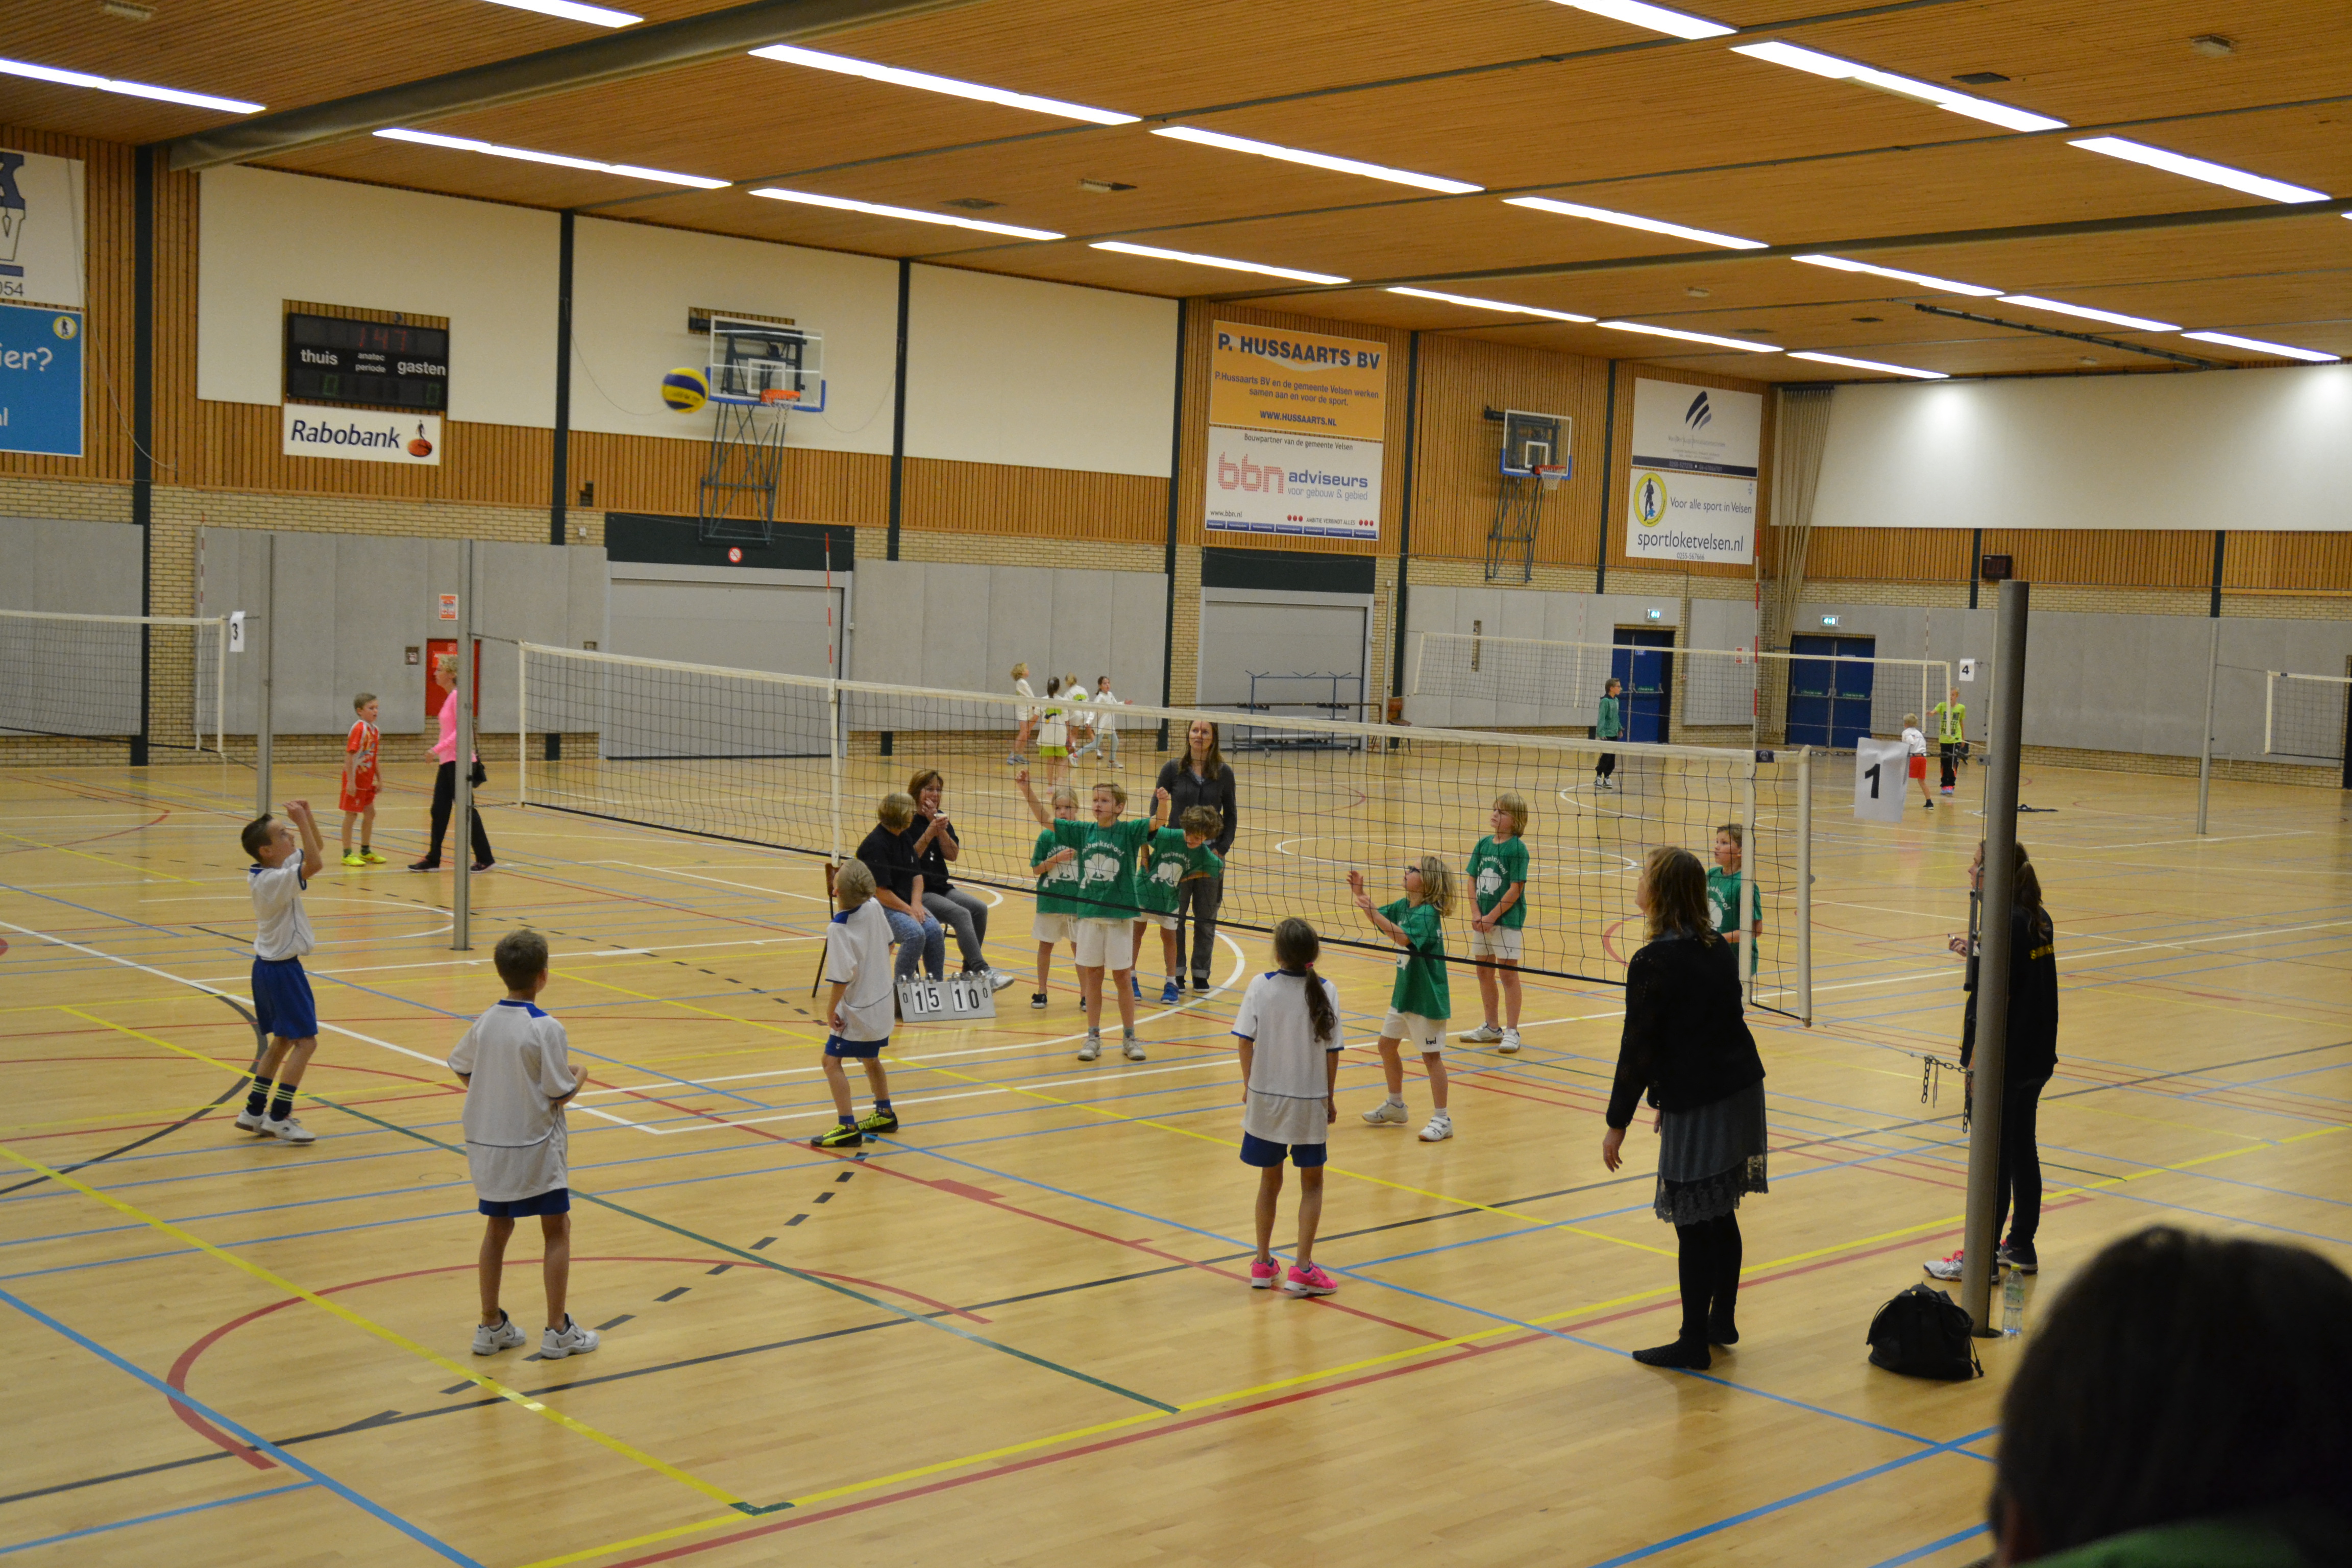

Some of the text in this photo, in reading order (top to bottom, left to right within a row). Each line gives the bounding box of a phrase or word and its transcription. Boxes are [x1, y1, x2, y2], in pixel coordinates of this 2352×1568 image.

[0, 281, 24, 296] 54
[300, 349, 338, 366] thuis
[1218, 332, 1381, 370] P. HUSSAARTS BV
[355, 363, 386, 374] periode
[397, 361, 447, 377] gasten
[1249, 388, 1273, 397] samen
[1275, 391, 1288, 399] aan
[1318, 395, 1327, 403] de
[1260, 376, 1270, 386] BV
[1283, 379, 1291, 388] de
[1294, 382, 1329, 393] gemeente
[1330, 385, 1352, 396] Velsen
[1354, 389, 1379, 399] werken
[1260, 410, 1337, 427] WWW.HUSSAARTS.NL
[291, 419, 401, 449] Rabobank
[1244, 433, 1283, 444] Bouwpartner
[1305, 440, 1333, 449] gemeente
[1335, 442, 1353, 450] Velsen
[1218, 451, 1368, 494] bbn adviseurs
[1288, 487, 1367, 501] voor gebouw & gebied
[1670, 496, 1752, 513] Voor alle sport in Velsen
[1637, 530, 1744, 552] sportloketvelsen.nl
[232, 623, 238, 640] 3
[1962, 665, 1969, 675] 4
[1865, 763, 1880, 799] 1
